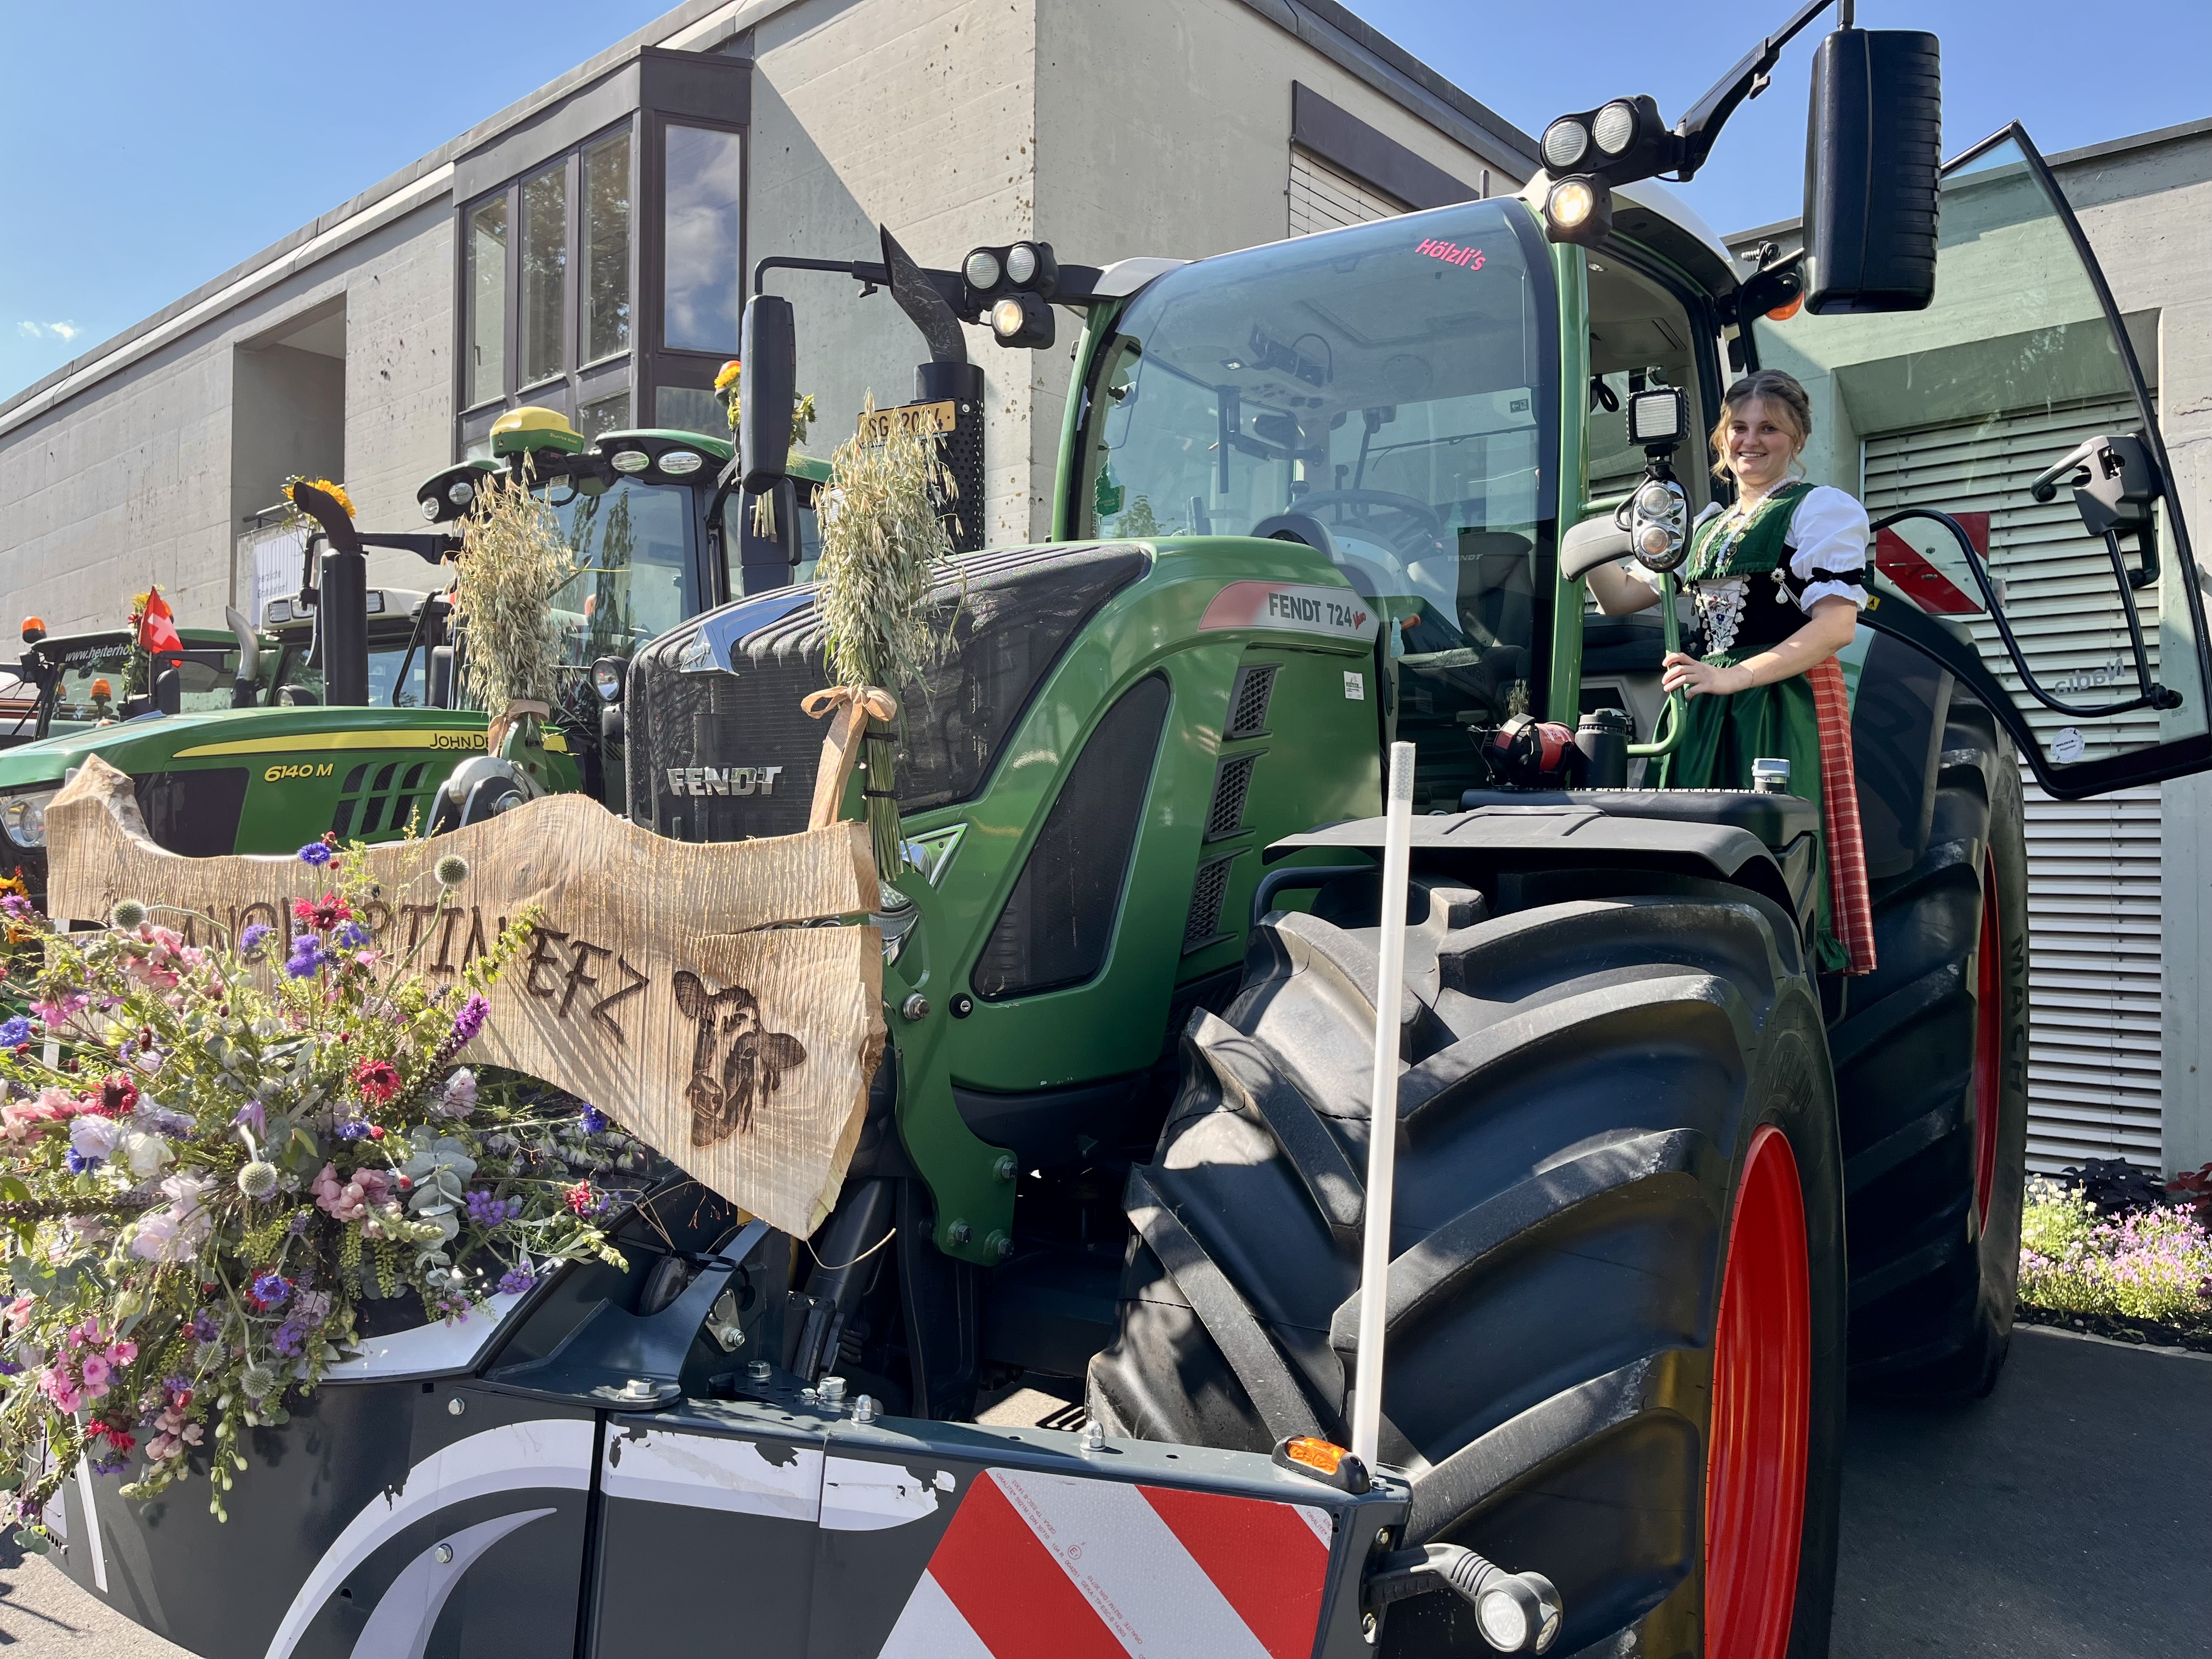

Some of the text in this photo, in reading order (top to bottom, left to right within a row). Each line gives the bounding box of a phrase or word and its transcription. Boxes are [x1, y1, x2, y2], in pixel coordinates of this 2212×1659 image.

[1415, 239, 1486, 270] Hölzli's
[869, 408, 943, 437] SG 204
[1447, 554, 1483, 562] FENDT
[1268, 592, 1322, 623] FENDT
[1327, 603, 1352, 627] 724
[65, 643, 132, 662] www.heiterho
[430, 733, 472, 748] JOHN
[264, 763, 334, 783] 6140 M
[666, 766, 783, 795] FENDT
[527, 927, 650, 1044] EFZ
[1012, 1480, 1025, 1494] 14303
[1029, 1515, 1039, 1525] DIN
[1037, 1524, 1050, 1539] 30710
[1043, 1519, 1056, 1534] GEKA
[1051, 1543, 1060, 1553] 104
[1064, 1560, 1080, 1578] 004251
[1087, 1575, 1101, 1591] 30710
[1099, 1590, 1108, 1601] DIN
[1081, 1581, 1094, 1596] GEKA
[1114, 1622, 1126, 1637] 14303
